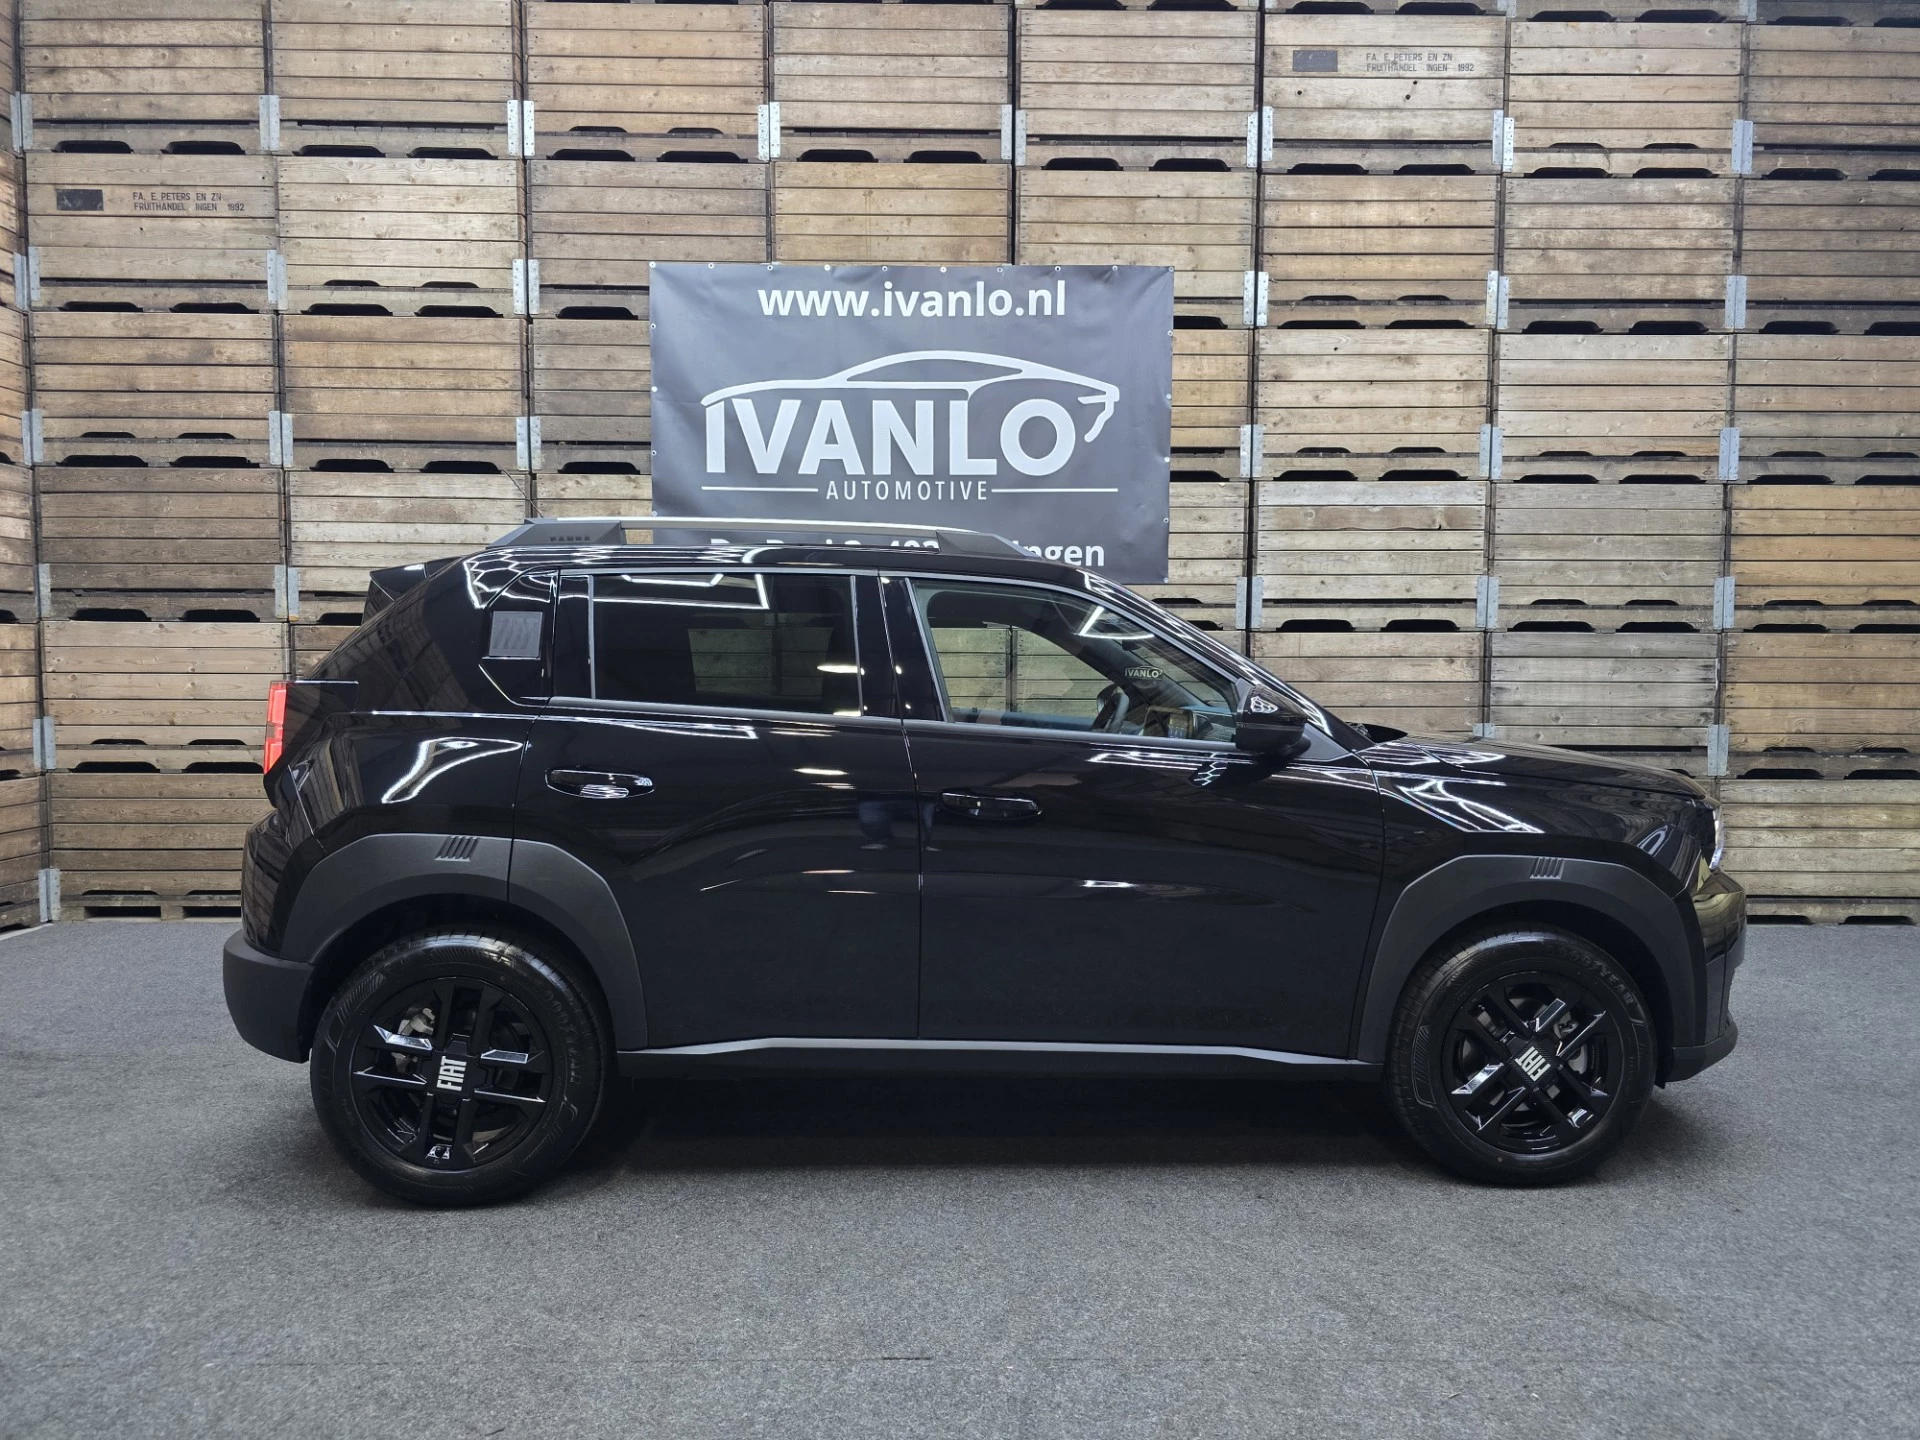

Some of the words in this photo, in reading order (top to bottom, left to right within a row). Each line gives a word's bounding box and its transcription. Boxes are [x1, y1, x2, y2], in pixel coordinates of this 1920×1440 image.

[1393, 52, 1423, 61] PETERS
[1427, 53, 1439, 61] EN
[1442, 53, 1453, 61] ZN
[1366, 62, 1418, 72] FRUITHANDEL
[1426, 63, 1448, 72] INGEN
[1457, 63, 1475, 72] 1992
[160, 192, 191, 201] PETERS
[195, 192, 207, 201] EN
[210, 192, 222, 201] ZN
[133, 202, 186, 211] FRUITHANDEL
[195, 202, 218, 211] INGEN
[757, 280, 1066, 317] www.ivanlo.nl
[704, 397, 1076, 477] IVANLO
[825, 480, 988, 500] AUTOMOTIVE
[1124, 667, 1160, 679] IVANLO
[1514, 1045, 1552, 1082] FIAT
[436, 1055, 467, 1092] FIAT
